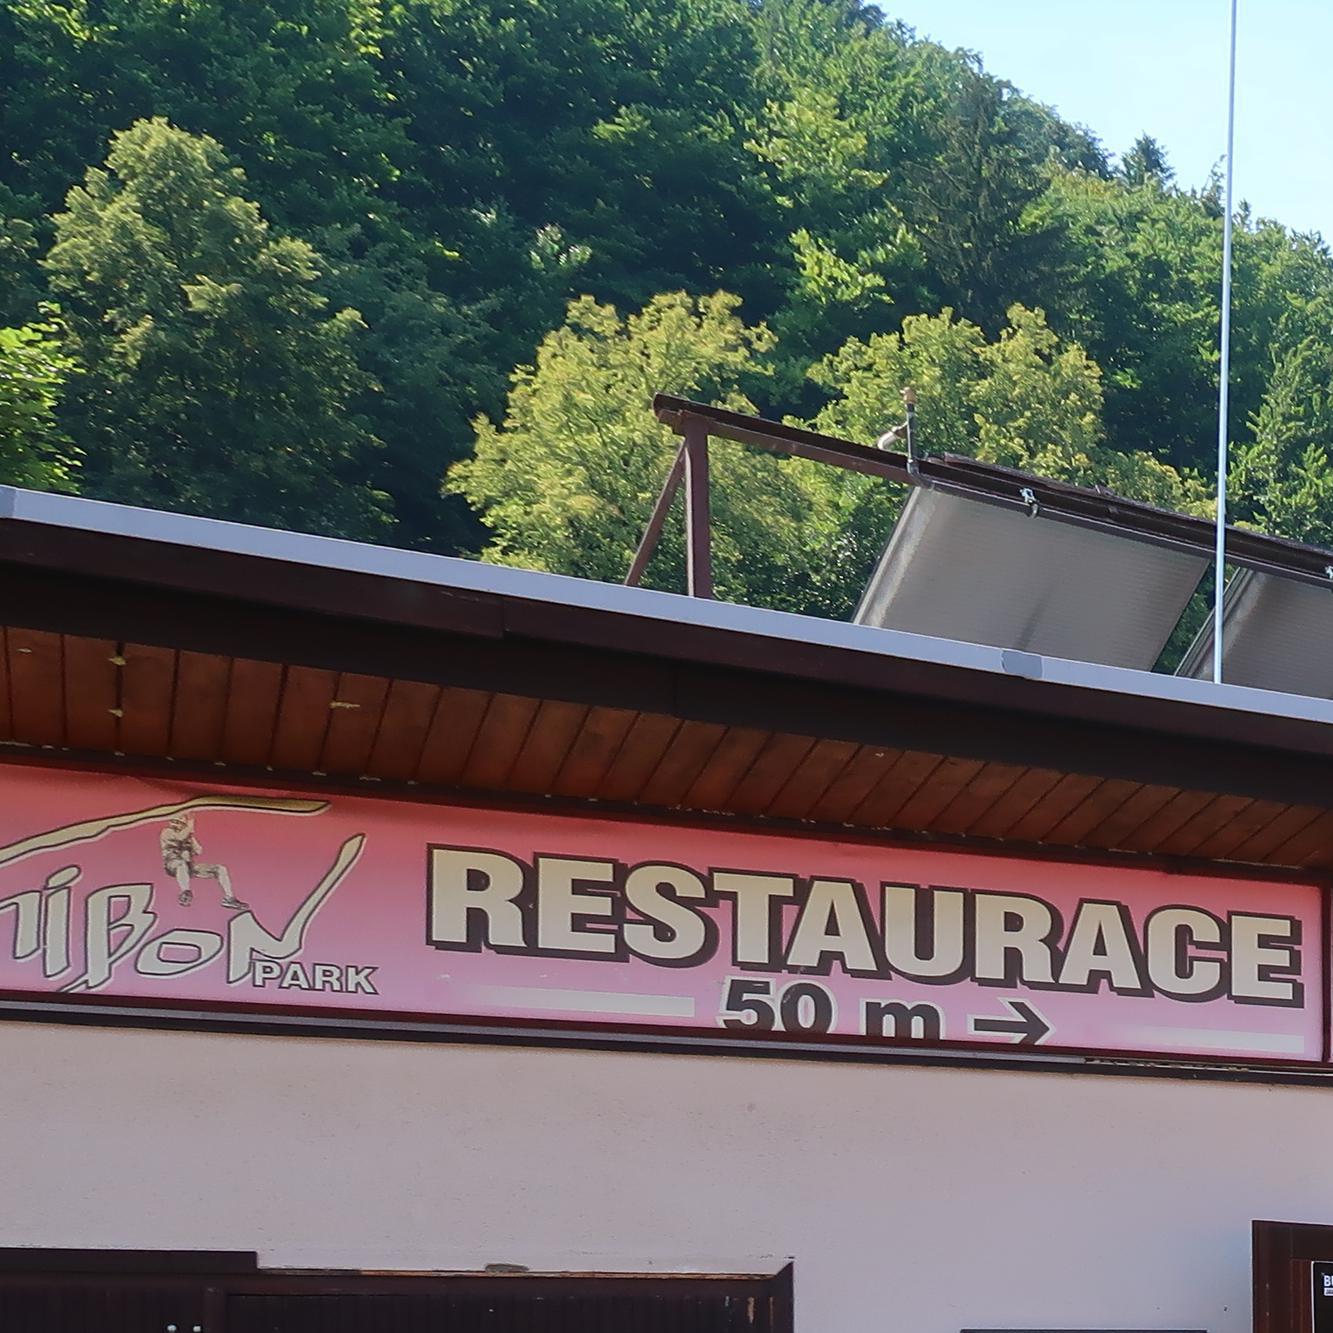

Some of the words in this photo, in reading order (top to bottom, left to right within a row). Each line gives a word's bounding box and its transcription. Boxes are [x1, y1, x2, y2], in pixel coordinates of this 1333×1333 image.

[427, 843, 1304, 1009] RESTAURACE
[252, 961, 379, 995] PARK
[719, 975, 838, 1035] 50
[859, 998, 946, 1041] m
